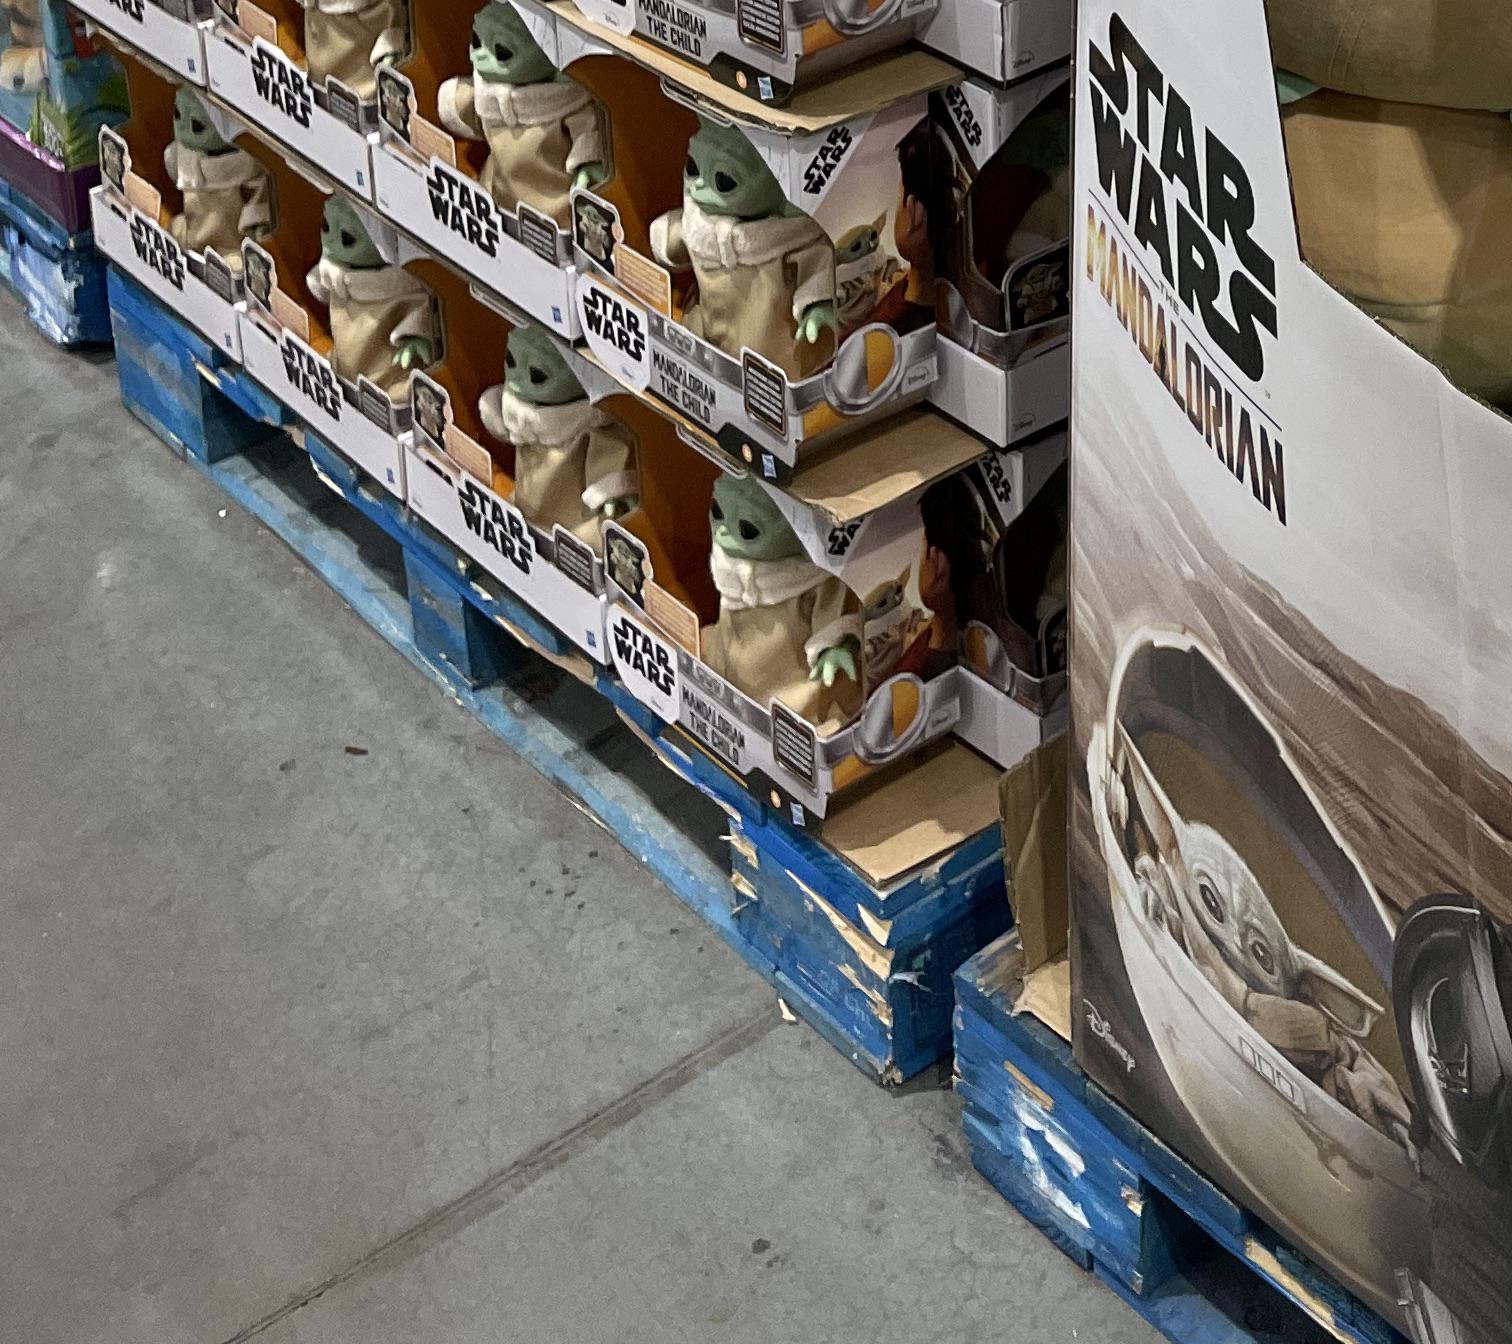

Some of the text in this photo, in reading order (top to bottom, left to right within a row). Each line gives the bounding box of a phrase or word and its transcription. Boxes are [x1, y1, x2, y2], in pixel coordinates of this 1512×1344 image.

[646, 15, 702, 58] THE CHILD
[250, 46, 311, 104] STAR
[253, 71, 312, 129] WARS
[946, 90, 981, 149] WARS
[947, 85, 983, 139] STAR
[803, 126, 849, 184] STAR
[803, 134, 854, 195] WARS
[1088, 12, 1276, 297] STAR
[427, 166, 498, 230] STAR
[427, 189, 500, 258] WARS
[129, 213, 182, 262] STAR
[1088, 77, 1278, 382] WARS
[131, 238, 186, 290] WARS
[583, 286, 645, 336] STAR
[1158, 279, 1180, 314] THE
[281, 335, 337, 393] STAR
[584, 309, 646, 363] WARS
[284, 361, 343, 422] WARS
[661, 375, 681, 405] THE
[1086, 204, 1287, 527] MANDALORIAN
[459, 480, 530, 551] STAR
[460, 502, 533, 575] WARS
[614, 617, 675, 675] STAR
[614, 642, 675, 697] WARS
